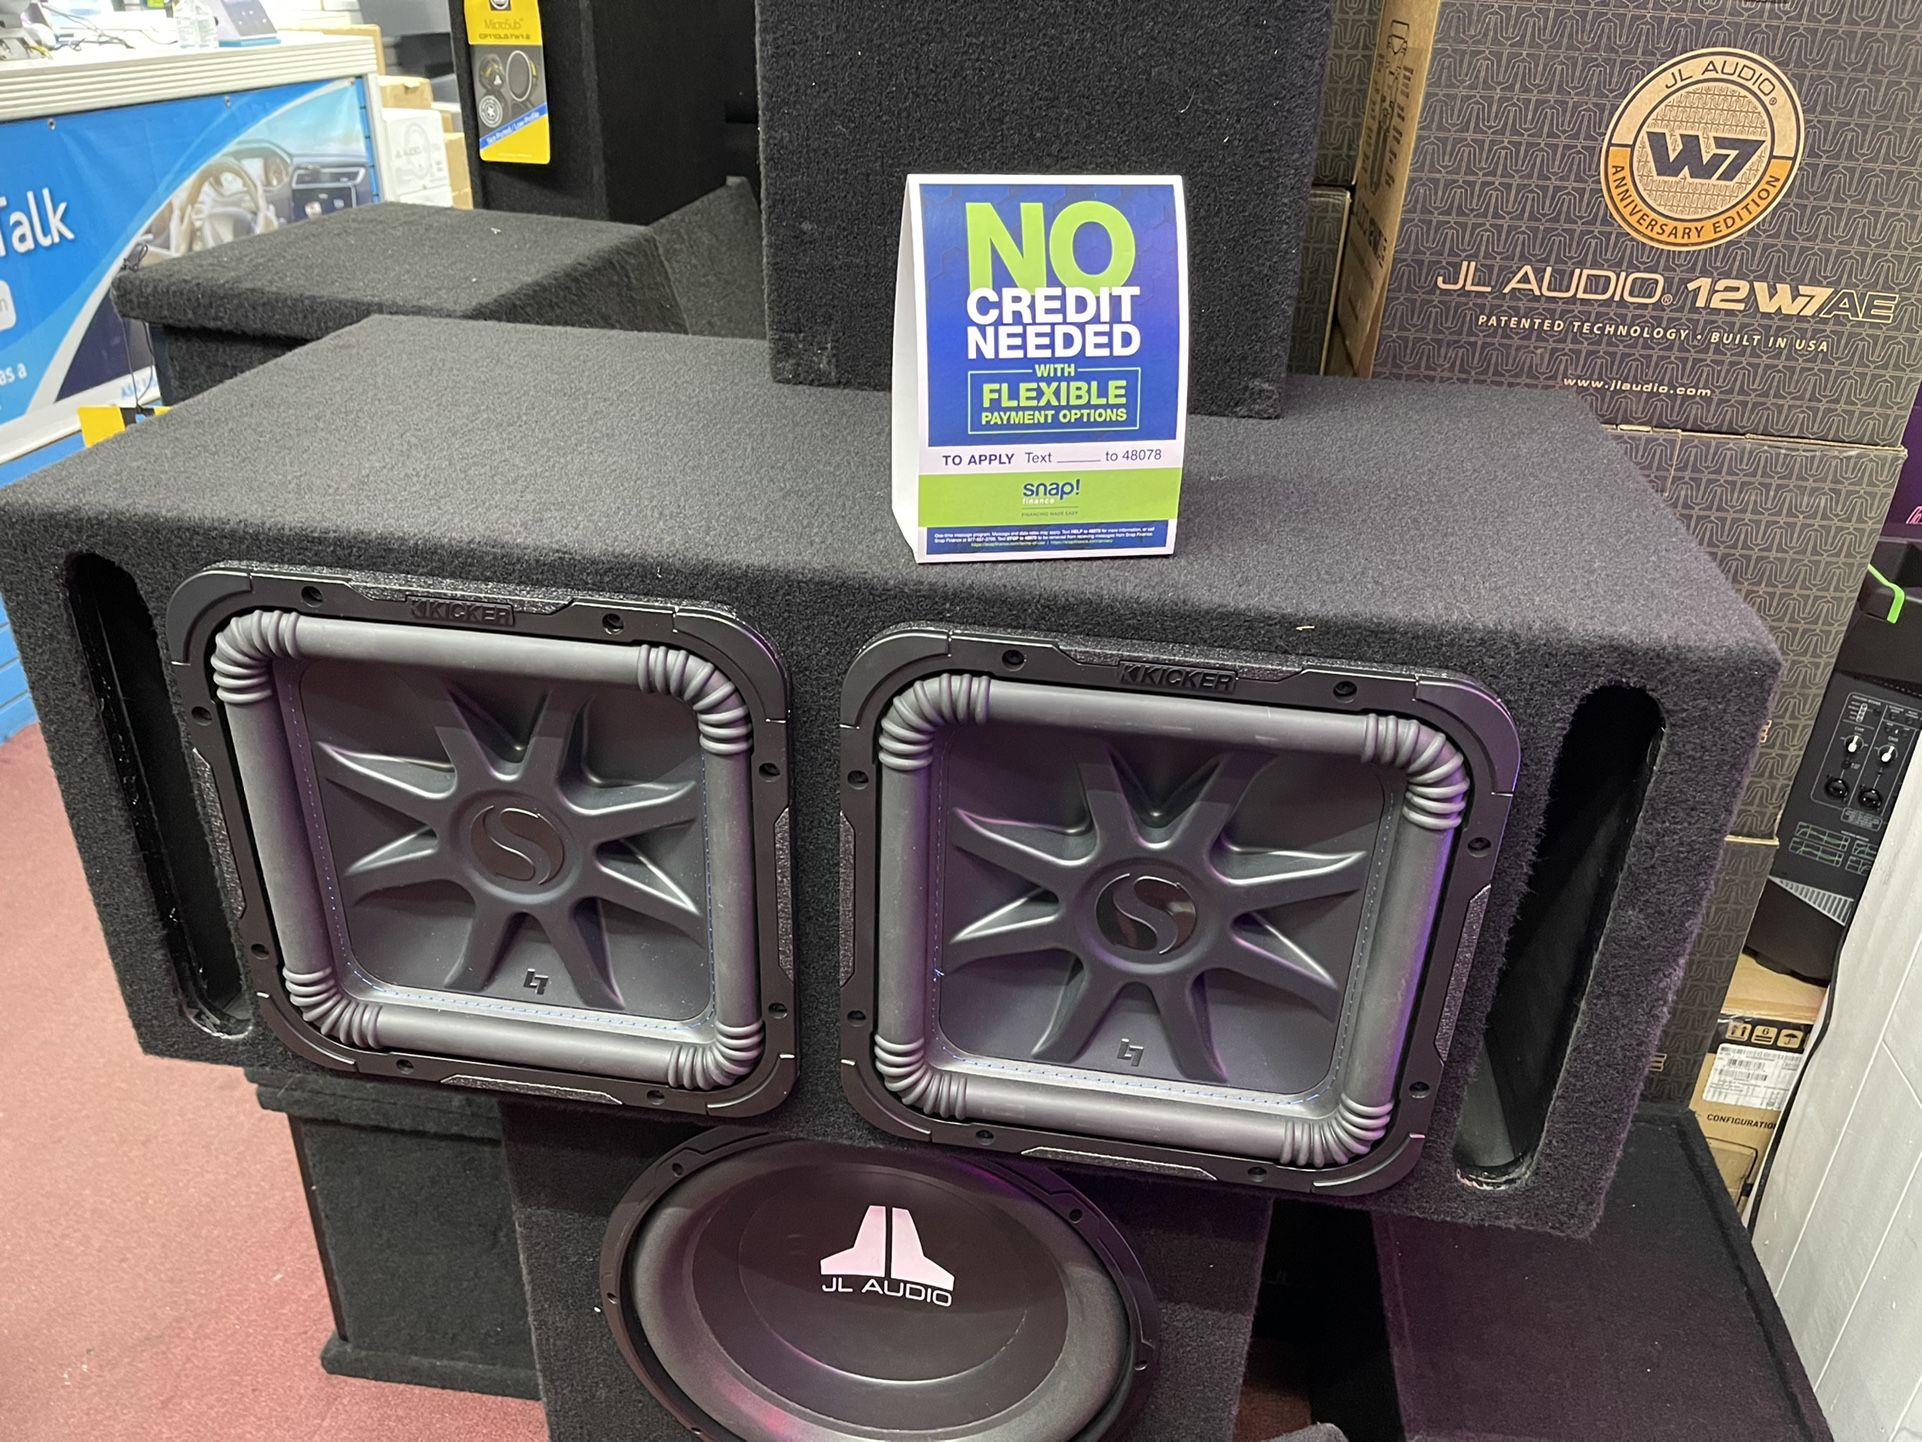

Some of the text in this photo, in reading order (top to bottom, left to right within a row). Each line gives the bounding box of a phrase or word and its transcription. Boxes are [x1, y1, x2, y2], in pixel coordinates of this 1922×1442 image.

[1665, 69, 1693, 89] JL
[1646, 131, 1766, 182] W7
[1612, 165, 1780, 240] ANNIVERSARY EDITION
[966, 201, 1136, 296] NO
[1436, 260, 1492, 293] JL
[966, 286, 1141, 325] CREDIT
[967, 323, 1141, 360] NEEDED
[1478, 315, 1828, 352] PATENTED TECHNOLOGY BUILT IN USA
[17, 362, 28, 379] a
[1035, 364, 1075, 377] WITH
[983, 380, 1127, 408] FLEXIBLE
[1563, 377, 1711, 397] www.jlaudio.com
[981, 408, 1127, 425] PAYMENT OPTIONS
[942, 449, 1162, 466] TO APPLY Text to 48078
[1023, 479, 1080, 500] snap!
[822, 1277, 952, 1307] JL AUDIO
